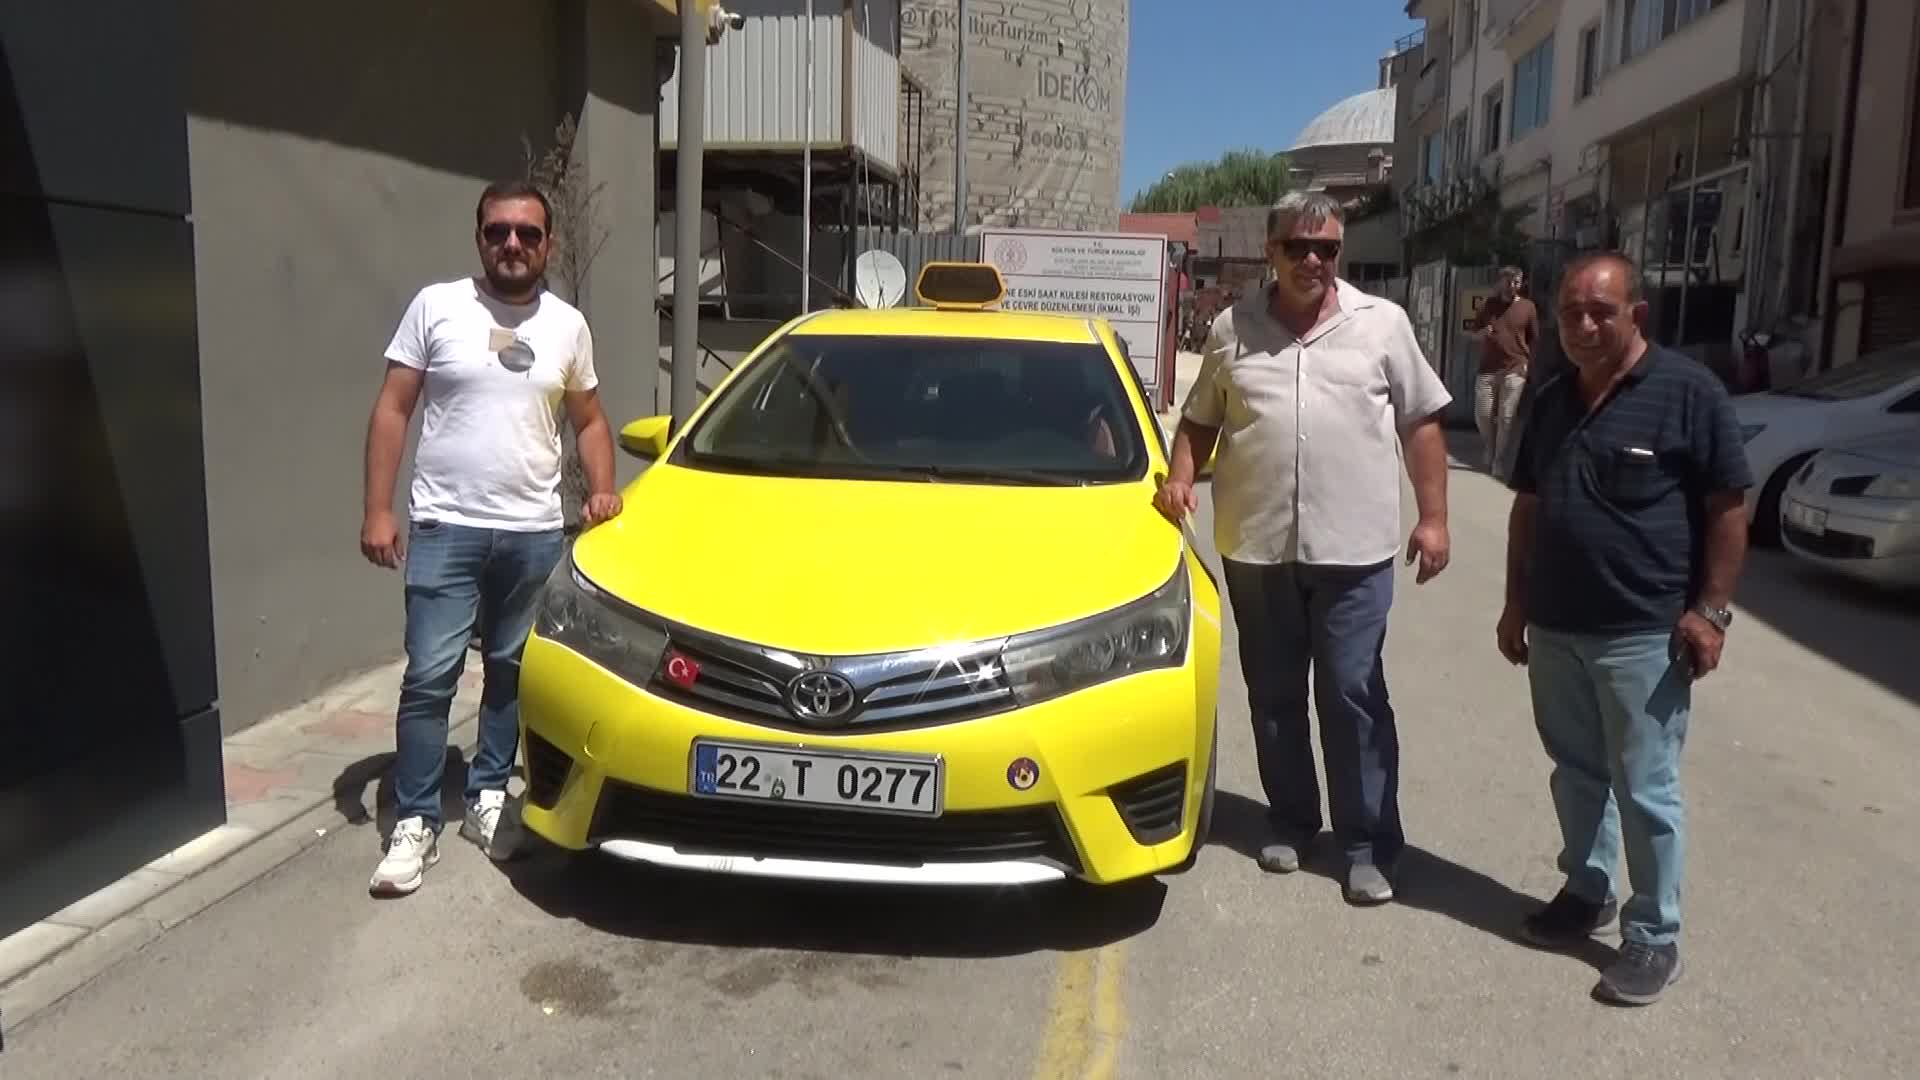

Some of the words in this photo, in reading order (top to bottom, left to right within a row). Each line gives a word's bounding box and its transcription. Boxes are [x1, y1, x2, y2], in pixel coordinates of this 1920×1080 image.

[1017, 287, 1036, 298] ESKİ
[1038, 289, 1058, 299] SAAT
[1060, 289, 1088, 300] KULESİ
[1090, 291, 1155, 303] RESTORASYONU
[1000, 301, 1011, 310] VE
[1012, 301, 1038, 311] ÇEVRE
[1040, 301, 1096, 313] DÜZENLEMESİ
[717, 753, 760, 792] 22
[792, 759, 813, 796] T
[837, 764, 931, 805] 0277
